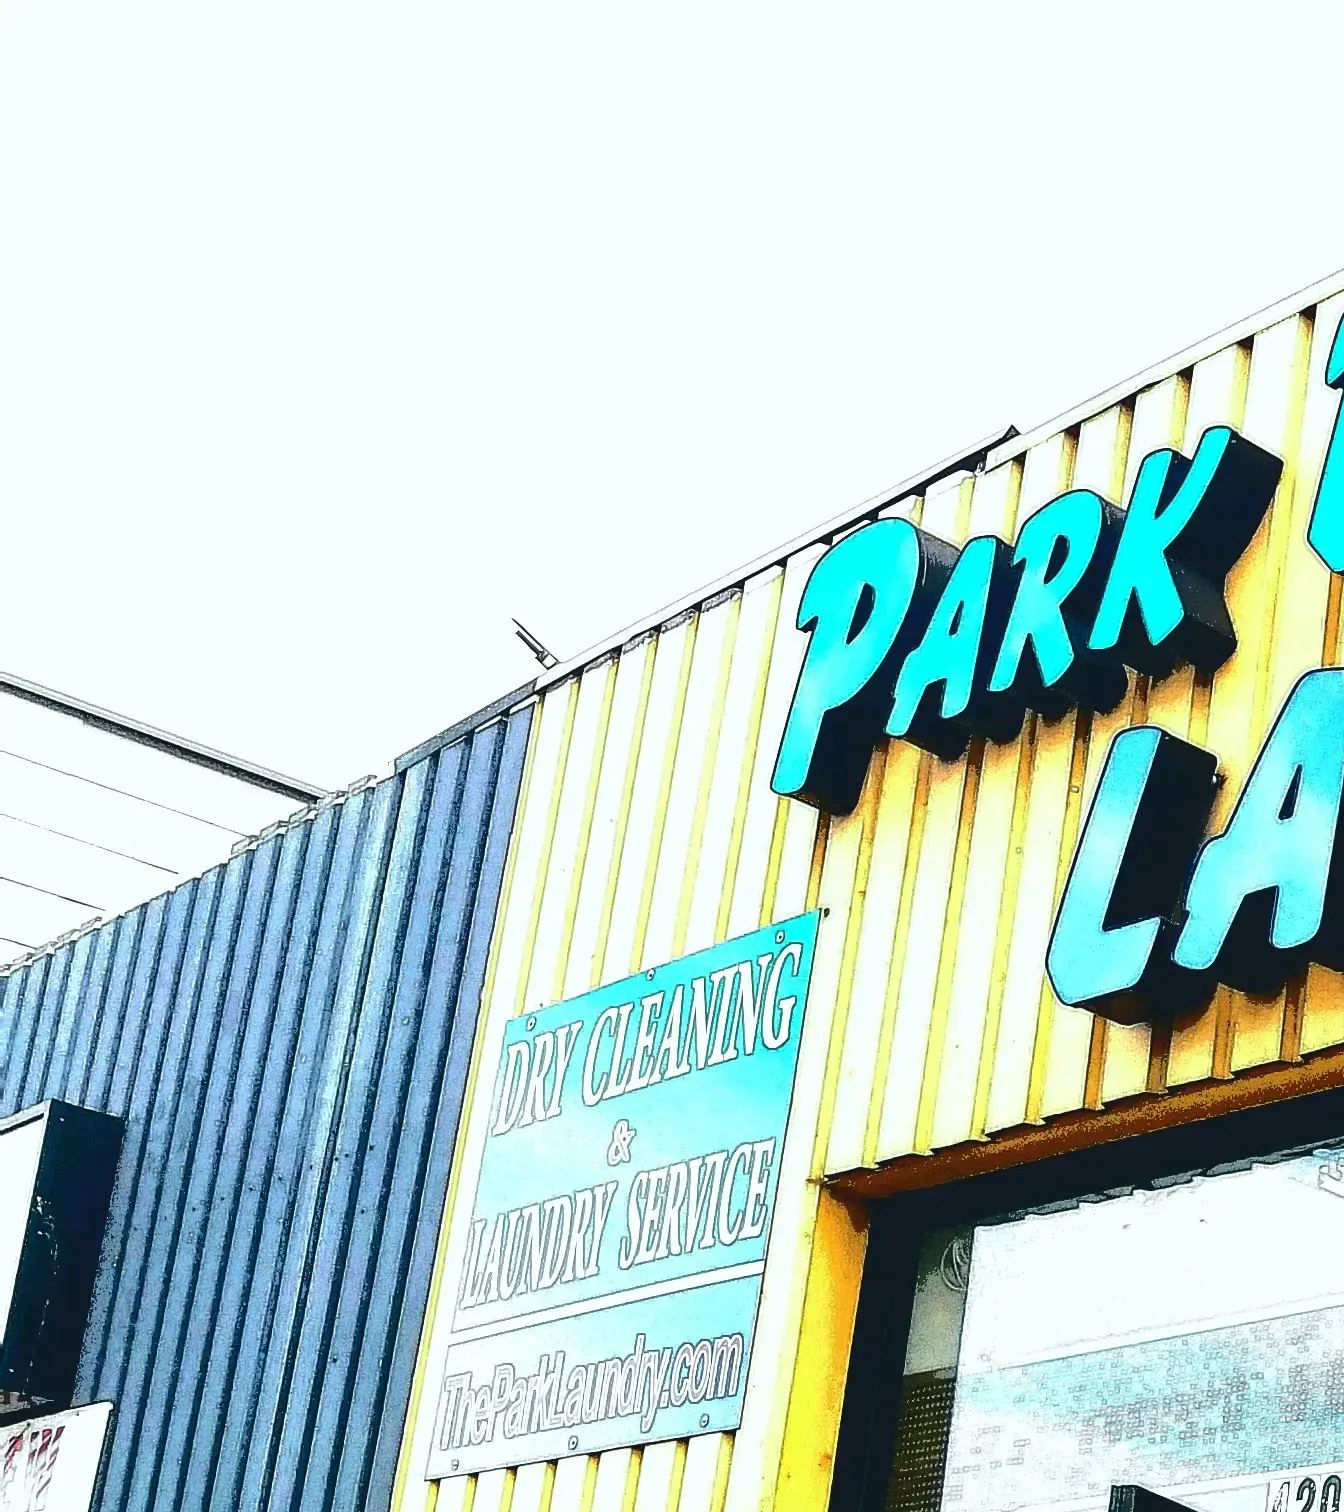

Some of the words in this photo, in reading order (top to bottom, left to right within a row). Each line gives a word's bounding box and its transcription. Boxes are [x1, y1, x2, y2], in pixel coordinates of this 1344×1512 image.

[770, 424, 1238, 796] PARK
[491, 1018, 585, 1138] DRY
[580, 941, 804, 1109] CLEANING
[458, 1180, 617, 1310] LAUNDRY
[617, 1137, 777, 1270] SERVICE
[606, 1118, 636, 1167] &
[438, 1332, 746, 1451] TheParkLaundry.com
